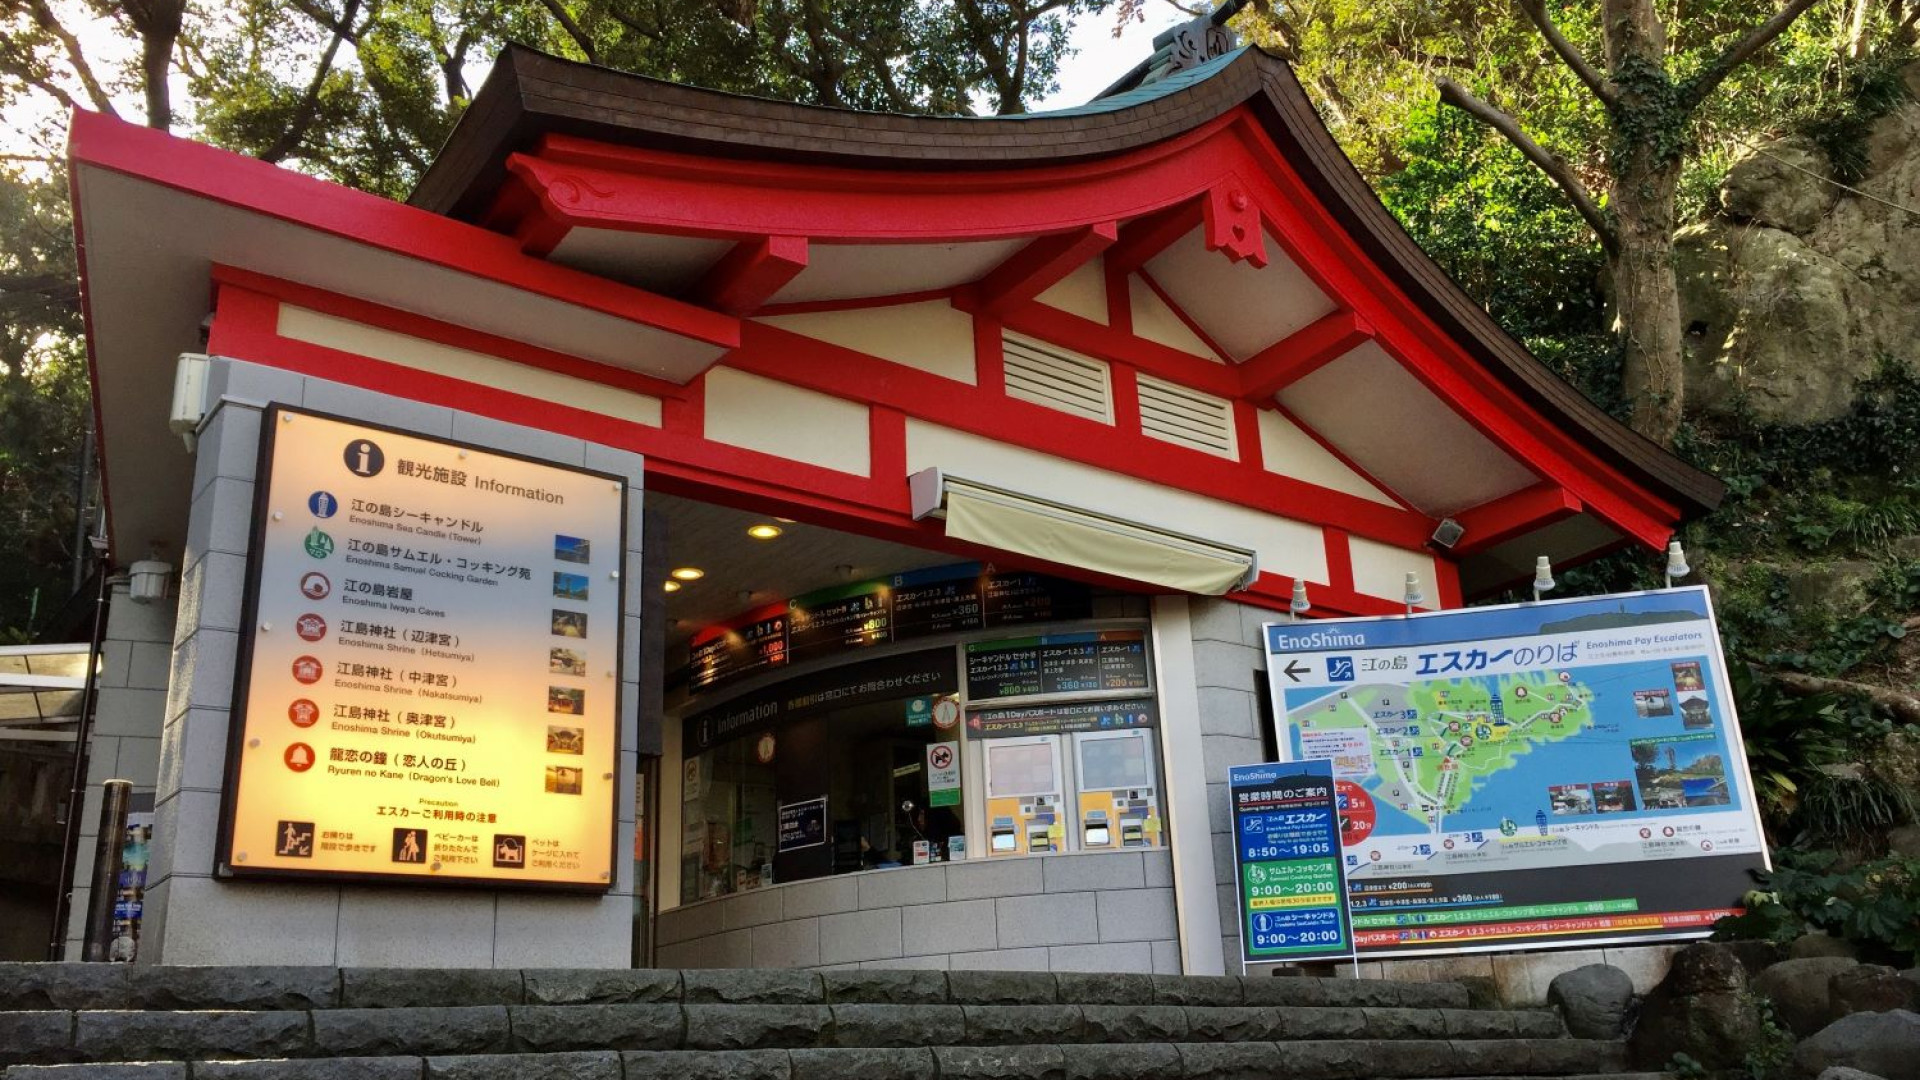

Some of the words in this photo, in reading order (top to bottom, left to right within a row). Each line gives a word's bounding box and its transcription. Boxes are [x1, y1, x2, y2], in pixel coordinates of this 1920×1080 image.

[397, 458, 467, 487] 観光施設
[475, 476, 565, 505] Information
[351, 498, 484, 533] 江の島シーキャンドル
[349, 515, 394, 531] Enoshima
[396, 522, 413, 534] Sea
[416, 526, 447, 540] Candle
[448, 530, 482, 546] (Tower)
[347, 538, 532, 581] 江の島サムエル・コッキング苑
[345, 554, 391, 570] Enoshima
[393, 561, 426, 575] Samuel
[428, 568, 465, 583] Cocking
[466, 573, 499, 587] Garden
[343, 578, 414, 601] 江の島岩屋
[894, 575, 903, 587] B
[342, 595, 388, 610] Enoshima
[389, 602, 416, 615] Iwaya
[418, 606, 446, 618] Caves
[789, 599, 798, 611] C
[863, 617, 888, 631] ¥800
[338, 636, 384, 651] Enoshima
[387, 643, 416, 655] Shrine
[1278, 632, 1366, 650] EnoShima
[1586, 637, 1633, 650] Enoshima
[1635, 635, 1653, 648] Pay
[1654, 631, 1703, 643] Escalators
[1361, 656, 1408, 671] 江の島
[334, 678, 381, 693] Enoshima
[383, 684, 413, 696] Shrine
[418, 687, 483, 704] (Nakatsumiya)
[999, 685, 1021, 696] ¥800
[1056, 680, 1079, 690] ¥360
[1105, 678, 1128, 687] ¥200
[717, 701, 779, 735] Information
[331, 721, 378, 735] Enoshima
[380, 726, 410, 738] Shrine
[416, 729, 476, 745] (Okutsumiya)
[327, 765, 362, 777] Ryuren
[364, 769, 377, 778] no
[379, 769, 404, 780] Kane
[408, 772, 454, 785] (Dragon's
[456, 775, 477, 787] Love
[479, 777, 501, 788] Bell)
[1233, 772, 1277, 781] EnoShima
[418, 798, 459, 808] Precaution
[1238, 787, 1327, 803] 営業時間のご案内
[376, 805, 498, 824] エスカーご利用時の注意
[1284, 813, 1327, 825] エスカー
